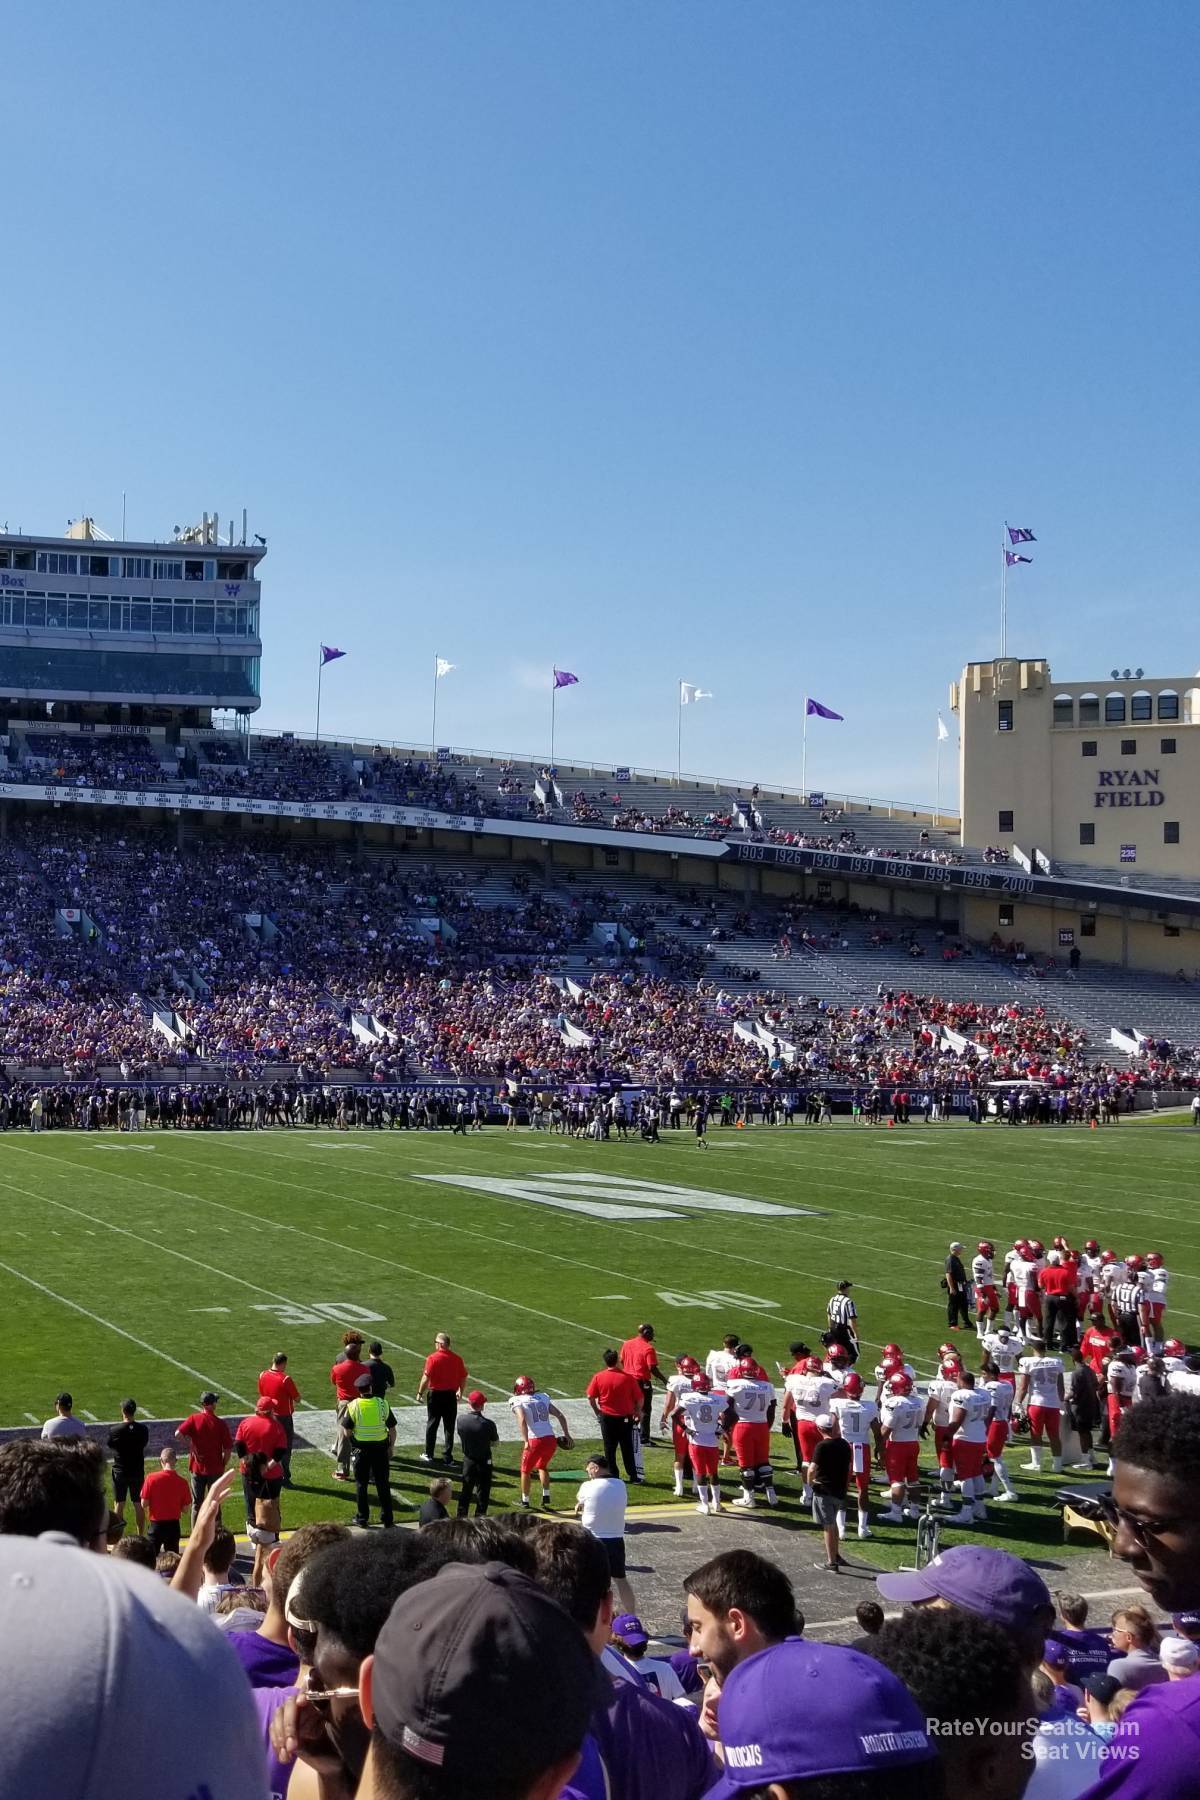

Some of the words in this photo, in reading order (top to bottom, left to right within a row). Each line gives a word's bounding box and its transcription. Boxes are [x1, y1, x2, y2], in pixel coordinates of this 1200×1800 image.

[1, 574, 25, 588] Box
[1099, 769, 1160, 786] RYAN
[1094, 790, 1165, 808] FIELD
[738, 844, 764, 860] 1903
[775, 849, 801, 864] 1926
[812, 853, 839, 869] 1930
[850, 857, 874, 874] 1931
[885, 861, 912, 878] 1936
[924, 866, 950, 882] 1995
[962, 871, 991, 888] 1996
[1002, 876, 1035, 893] 2000
[1060, 933, 1073, 941] 135
[408, 1172, 822, 1220] N
[654, 1290, 782, 1310] 40
[1120, 1289, 1131, 1302] U
[250, 1302, 388, 1325] 30
[744, 1391, 766, 1412] 71
[699, 1405, 712, 1424] 8
[851, 1407, 860, 1433] 1
